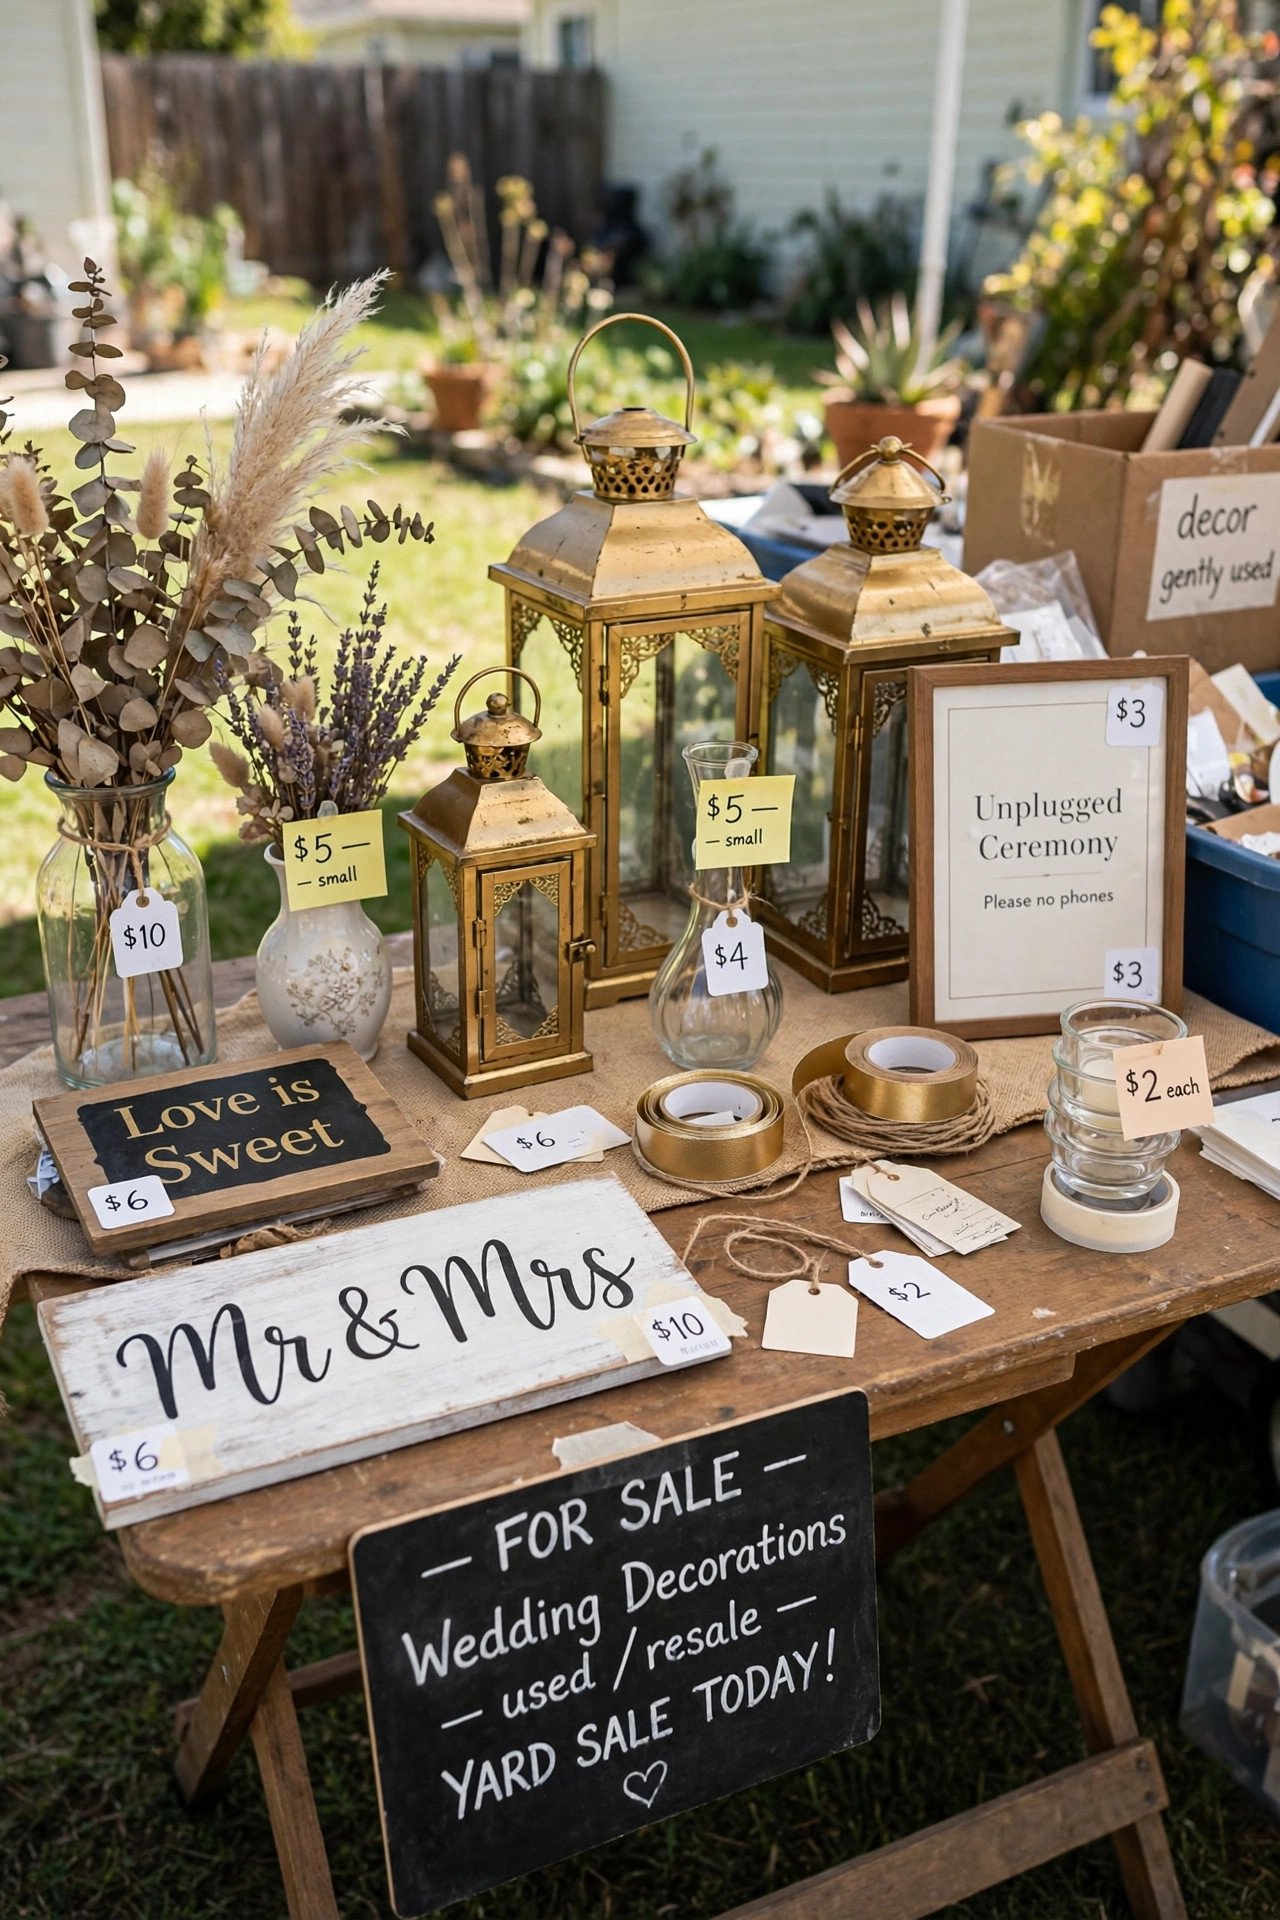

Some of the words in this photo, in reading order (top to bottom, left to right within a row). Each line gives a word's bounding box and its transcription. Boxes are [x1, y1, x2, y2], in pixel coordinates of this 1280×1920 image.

[1177, 493, 1258, 540] decor
[1160, 554, 1224, 604] gently
[1231, 548, 1274, 582] used
[1116, 697, 1146, 728] $3
[707, 794, 744, 824] $5
[975, 788, 1123, 827] Unplugged
[294, 833, 332, 864] $5
[725, 828, 763, 847] small
[978, 834, 1119, 863] Ceremony
[317, 866, 357, 888] small
[983, 893, 1031, 910] Please
[1036, 895, 1056, 907] no
[1060, 888, 1114, 909] phones
[123, 922, 166, 950] $10
[715, 941, 748, 970] $4
[1113, 960, 1143, 989] $3
[1126, 1069, 1162, 1103] $2
[1167, 1075, 1201, 1099] each
[113, 1091, 260, 1140] Love
[268, 1076, 321, 1107] is
[144, 1118, 345, 1185] Sweet
[516, 1131, 556, 1150] $6
[105, 1189, 149, 1212] $6
[888, 1282, 931, 1303] $2
[116, 1302, 333, 1421] Mr
[338, 1286, 421, 1360] &
[400, 1238, 636, 1344] Mrs
[652, 1312, 704, 1341] $10
[109, 1441, 158, 1472] $6
[494, 1498, 594, 1572] FOR
[619, 1450, 743, 1532] SALE
[401, 1594, 602, 1687] Wedding
[621, 1513, 847, 1614] Decorations
[502, 1652, 597, 1719] used
[440, 1741, 556, 1821] YARD
[576, 1697, 674, 1768] SALE
[693, 1627, 837, 1722] TODAY!
